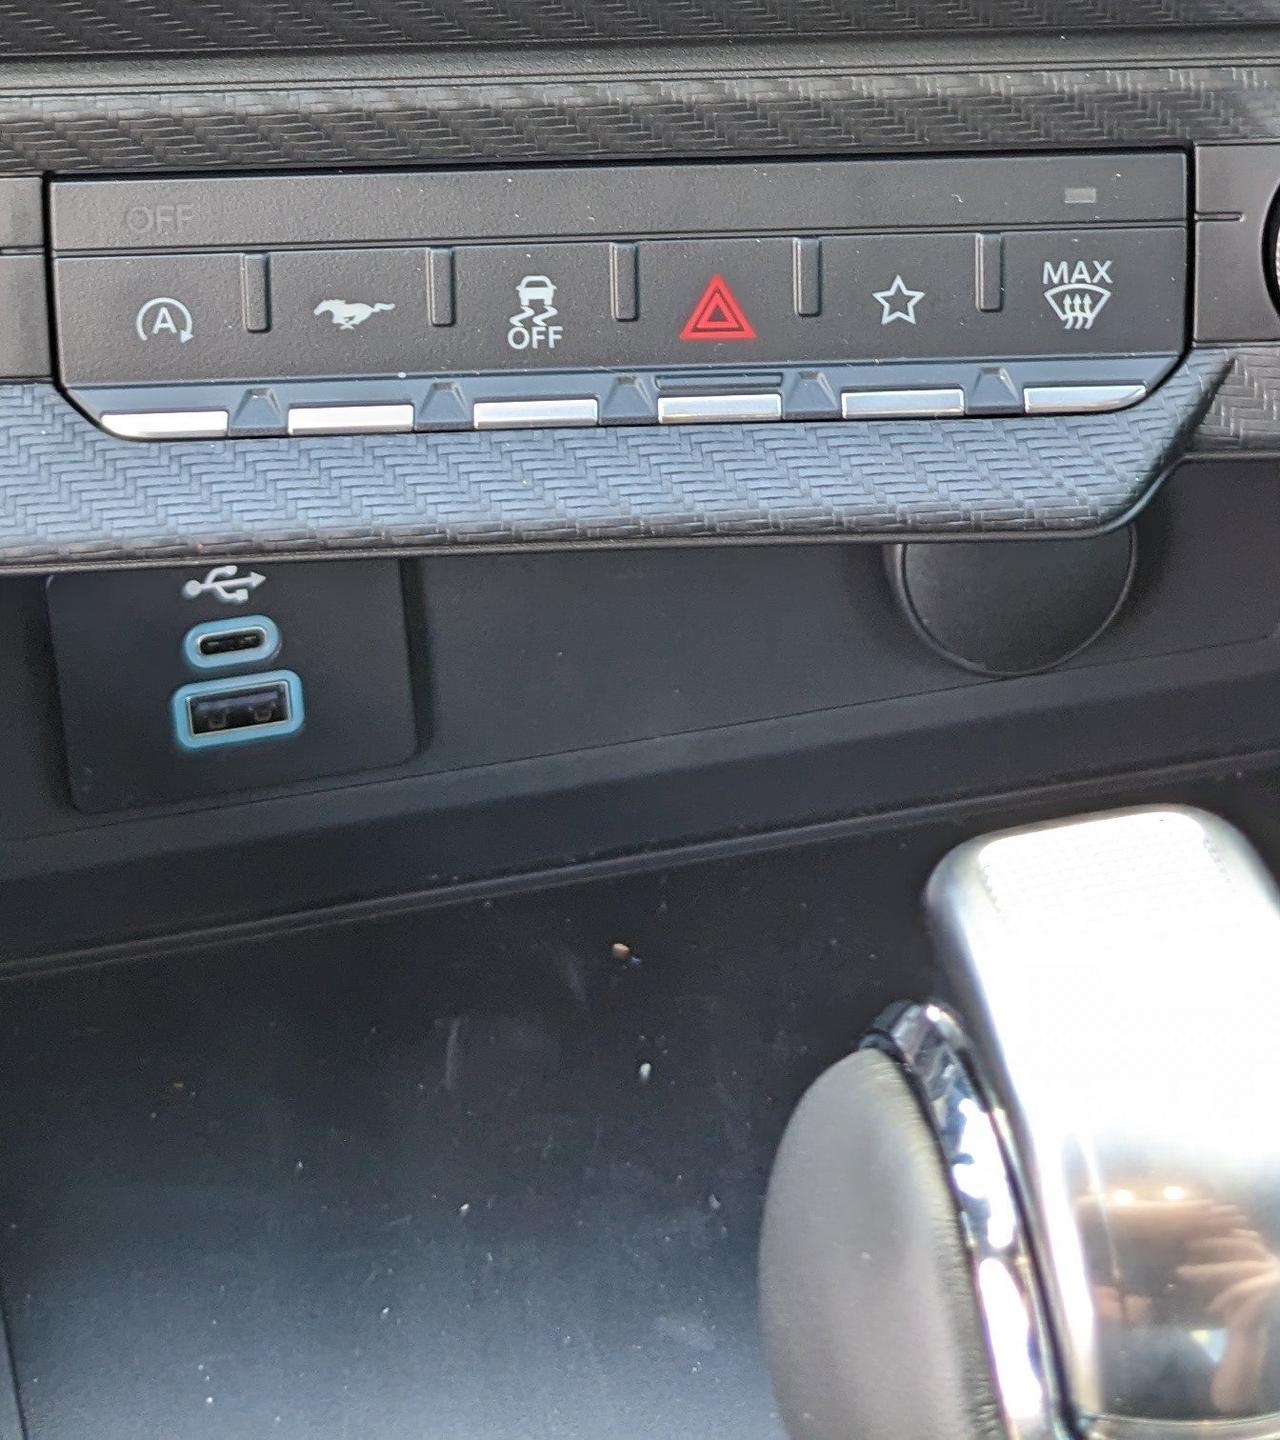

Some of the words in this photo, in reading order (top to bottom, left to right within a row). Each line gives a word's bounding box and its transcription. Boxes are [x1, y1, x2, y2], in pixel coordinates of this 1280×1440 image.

[125, 203, 194, 234] OFF
[1043, 261, 1112, 284] MAX
[508, 320, 562, 349] OFF
